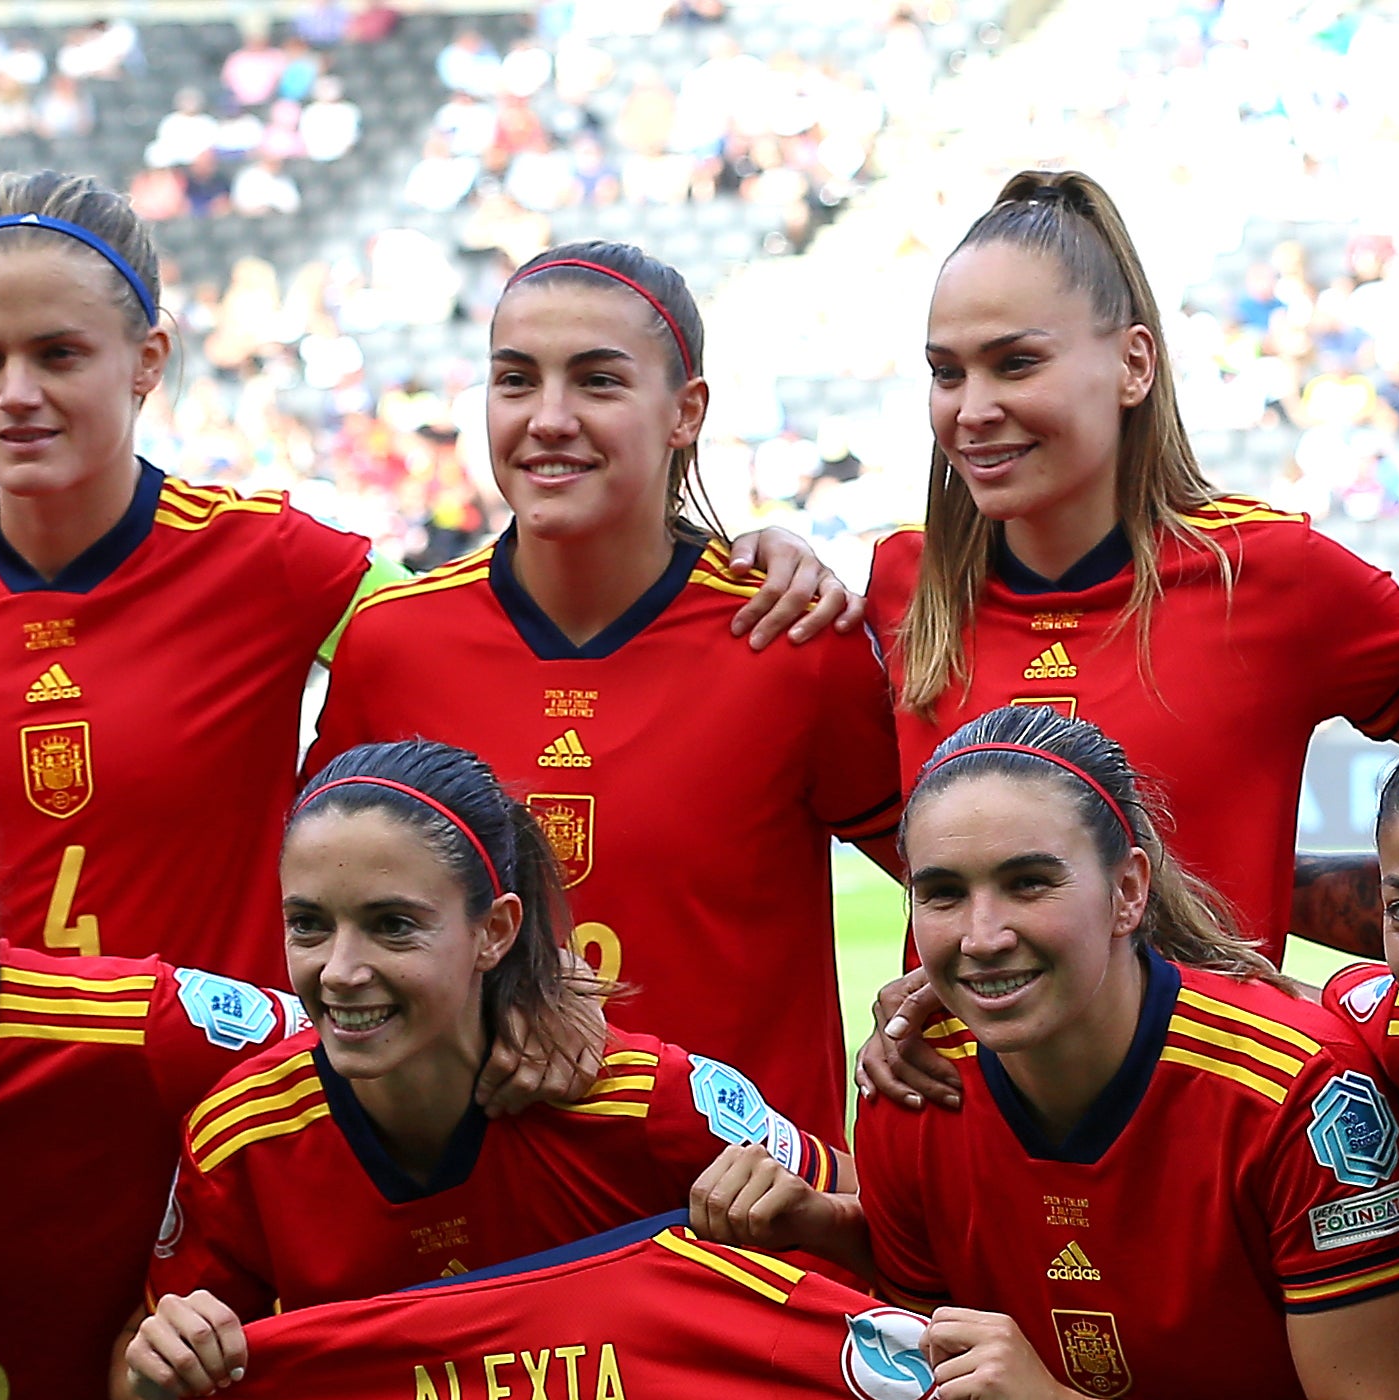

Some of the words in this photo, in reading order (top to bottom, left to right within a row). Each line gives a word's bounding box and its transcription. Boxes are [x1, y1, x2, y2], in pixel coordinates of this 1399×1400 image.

[1024, 665, 1077, 679] adidas
[25, 686, 82, 703] adidas
[538, 753, 591, 767] adidas
[44, 846, 99, 956] 4
[1313, 1203, 1344, 1219] UEFA
[1047, 1266, 1101, 1280] adidas
